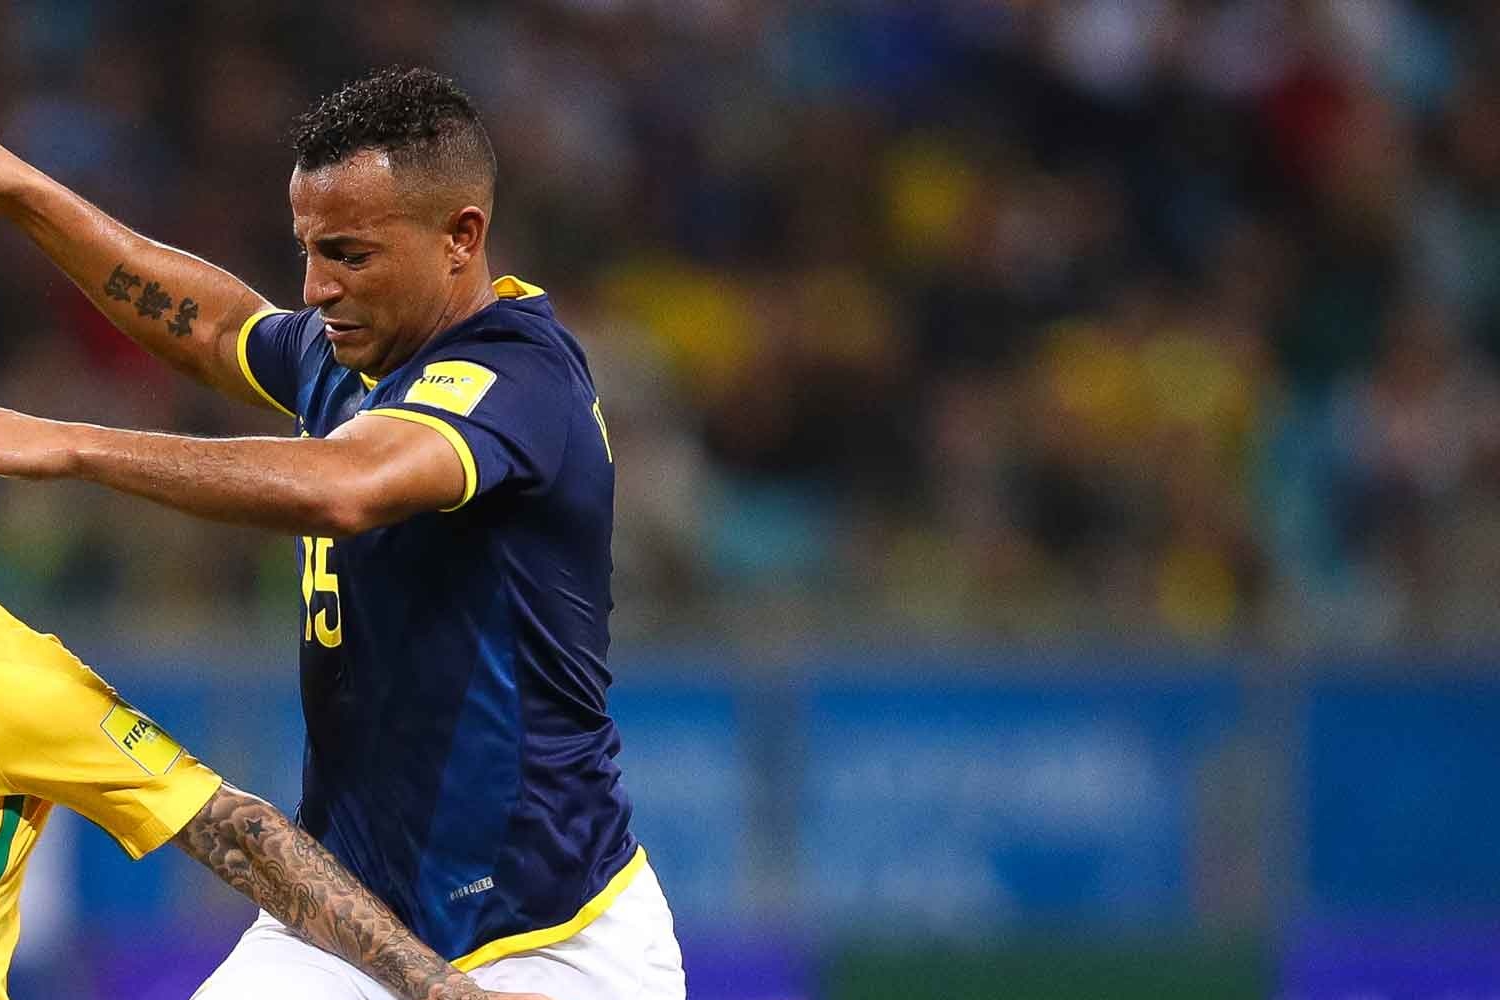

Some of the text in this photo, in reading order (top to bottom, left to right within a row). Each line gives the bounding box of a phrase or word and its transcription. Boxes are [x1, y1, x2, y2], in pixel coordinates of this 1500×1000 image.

[420, 375, 455, 385] FIFA
[302, 536, 342, 648] 15
[123, 719, 150, 751] FIFA
